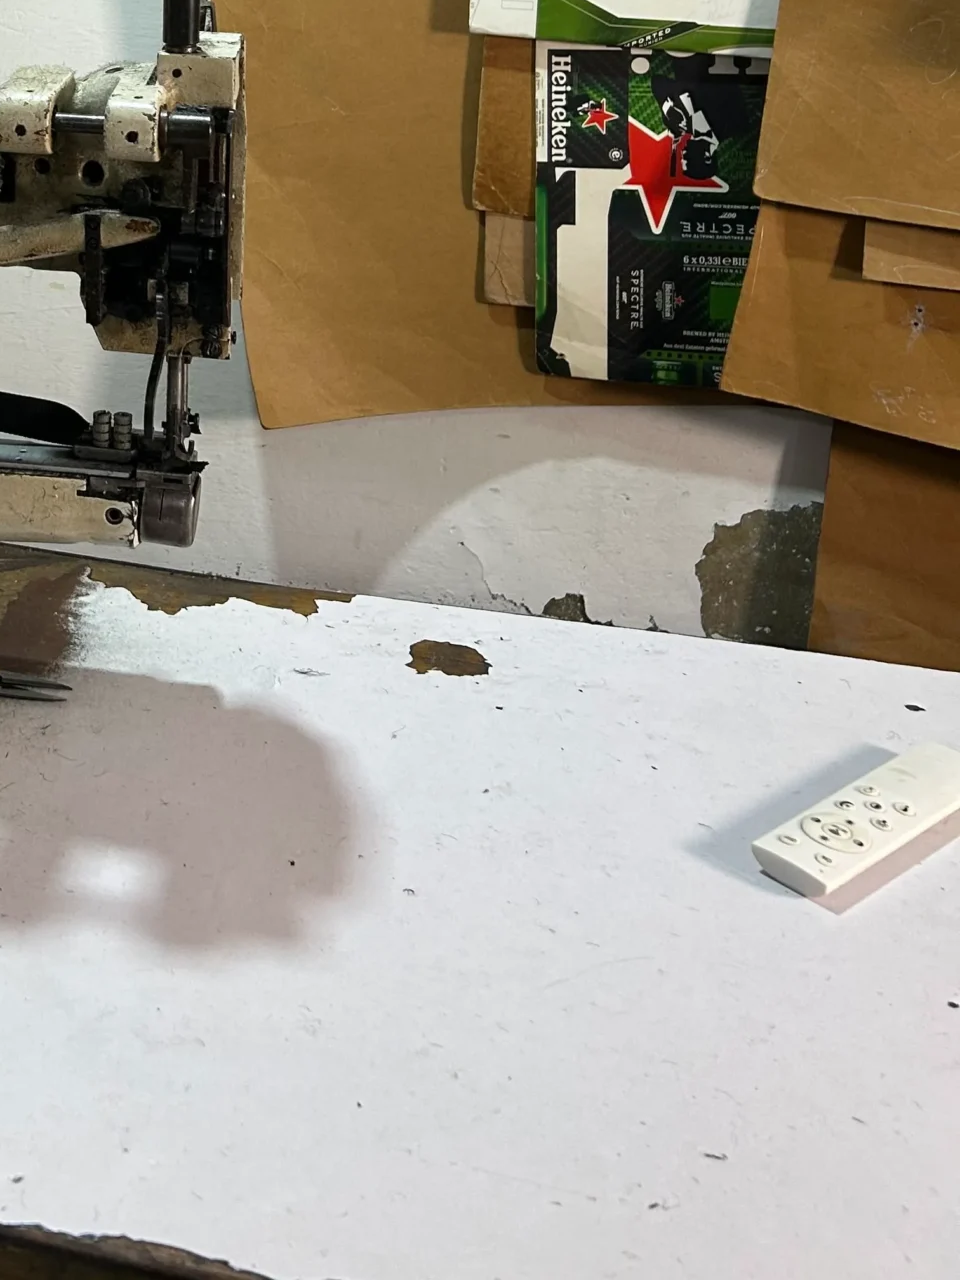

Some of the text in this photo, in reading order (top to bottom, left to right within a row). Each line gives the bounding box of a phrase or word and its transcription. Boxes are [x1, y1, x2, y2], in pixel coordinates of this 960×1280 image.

[624, 27, 672, 48] MPORTED
[551, 54, 571, 162] Heineken
[680, 221, 757, 235] PECTRE
[683, 254, 690, 264] 6
[732, 257, 748, 267] BIE
[630, 269, 639, 330] SPECTRE
